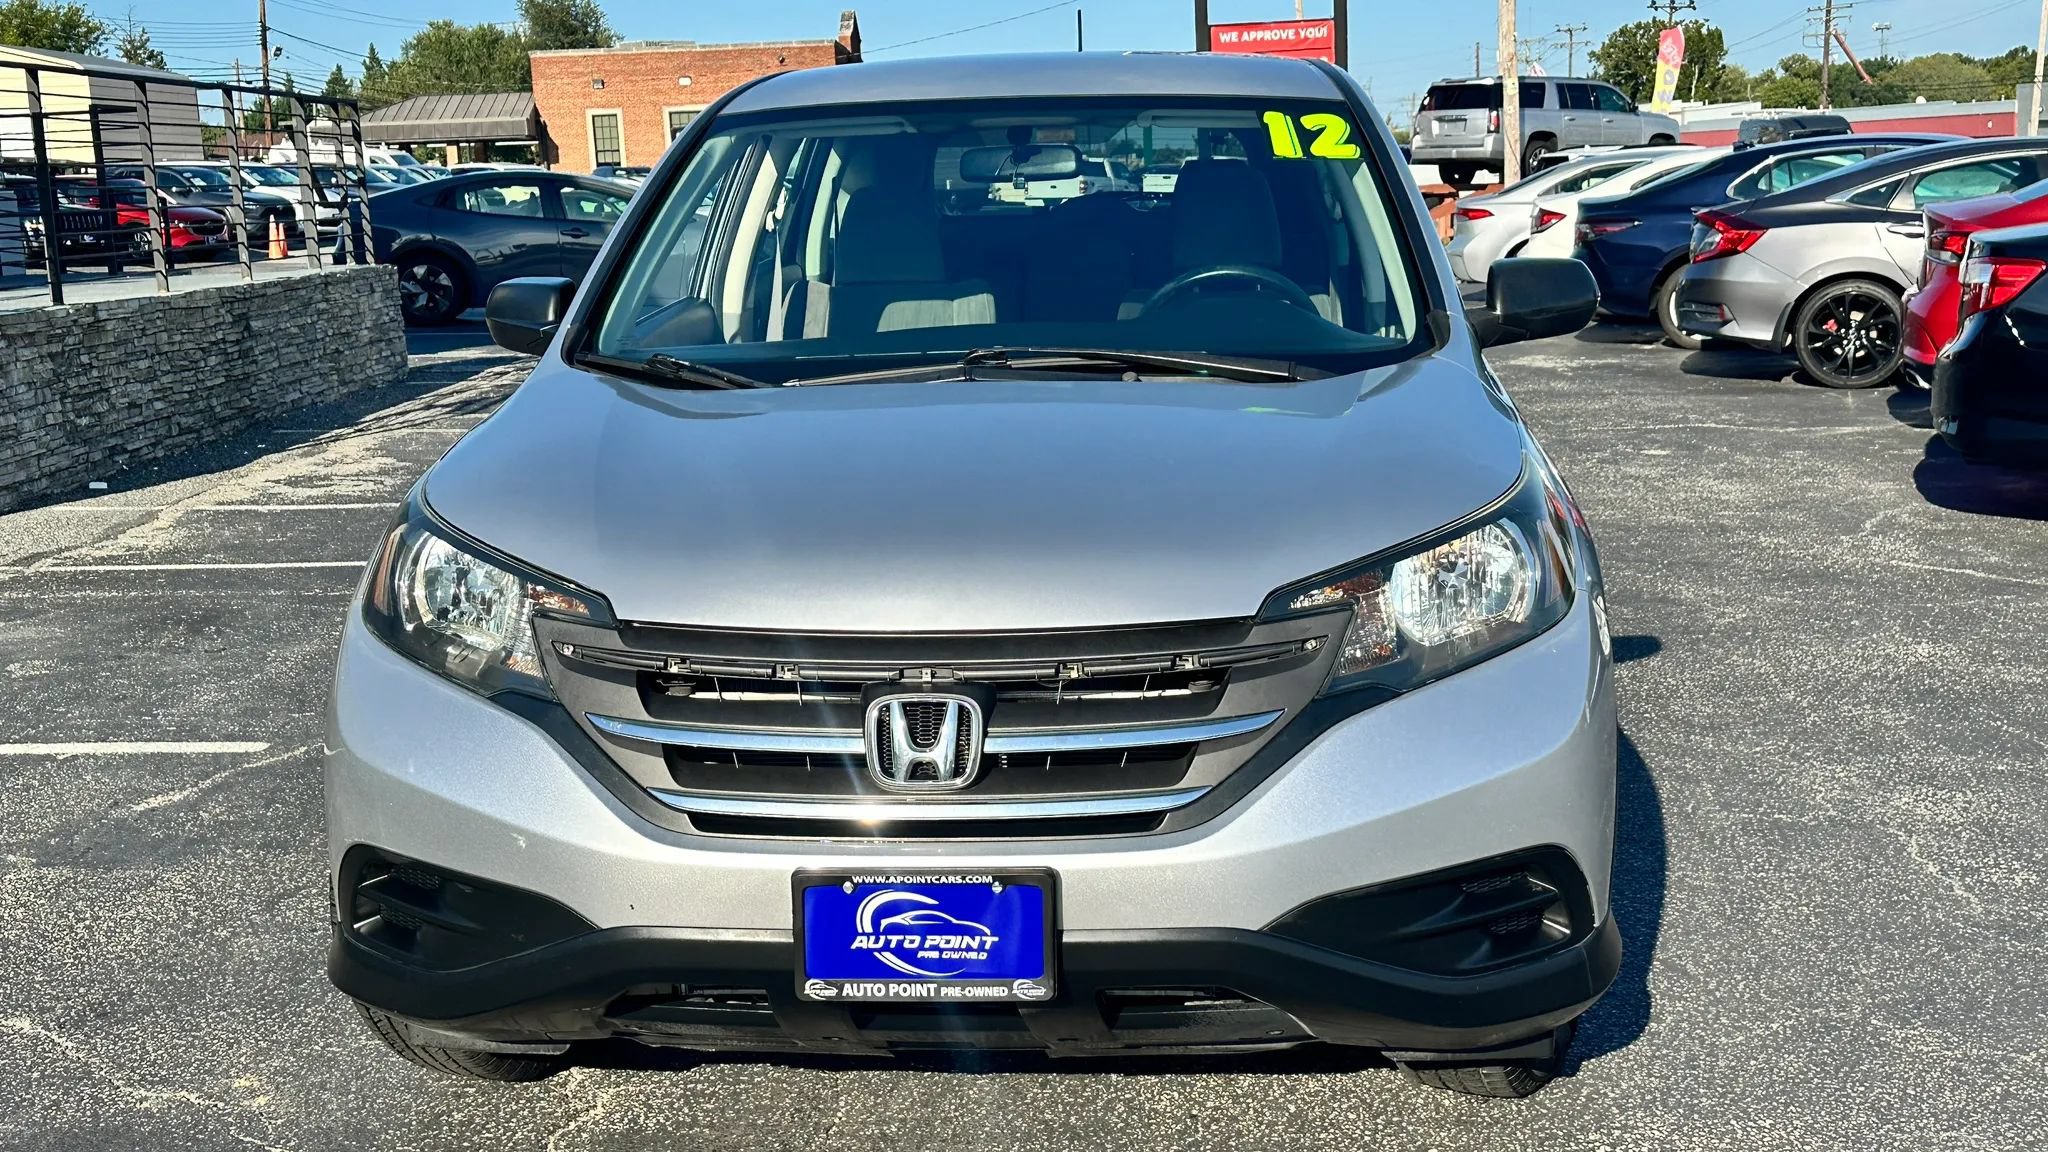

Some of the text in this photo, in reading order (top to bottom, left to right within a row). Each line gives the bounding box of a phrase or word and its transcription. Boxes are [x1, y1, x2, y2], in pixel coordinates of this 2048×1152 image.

[1219, 31, 1238, 43] WE
[1241, 28, 1296, 42] APPROVE
[1263, 111, 1361, 158] 12
[852, 875, 993, 884] WWW.APOINTCARS.COM
[850, 935, 999, 949] AUTO POINT
[917, 951, 988, 960] PRE OWNED
[842, 984, 886, 997] AUTO
[889, 983, 937, 997] POINT
[941, 987, 1008, 997] PRE-OWNED
